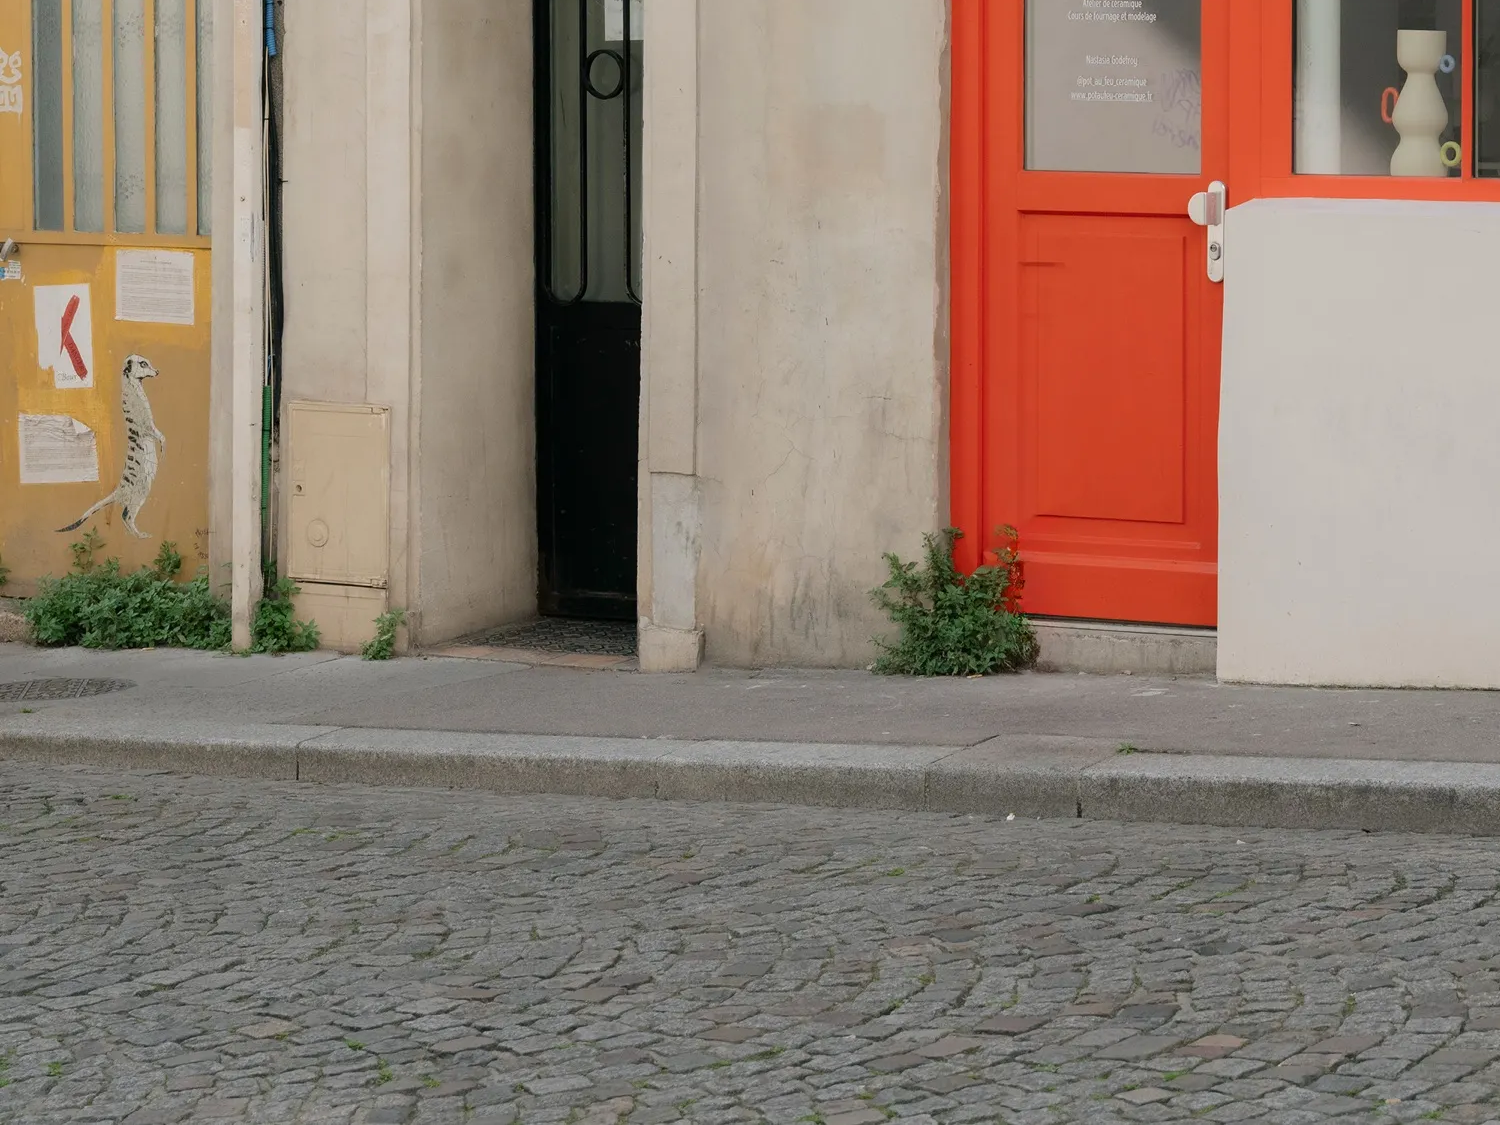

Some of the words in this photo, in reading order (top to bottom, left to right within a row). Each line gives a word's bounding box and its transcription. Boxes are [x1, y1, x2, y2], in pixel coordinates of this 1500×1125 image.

[1067, 10, 1084, 20] Cours
[1085, 11, 1093, 21] de
[1093, 11, 1120, 23] tournage
[1120, 11, 1127, 21] et
[1127, 11, 1157, 23] modelage
[1111, 55, 1138, 68] Godefroy
